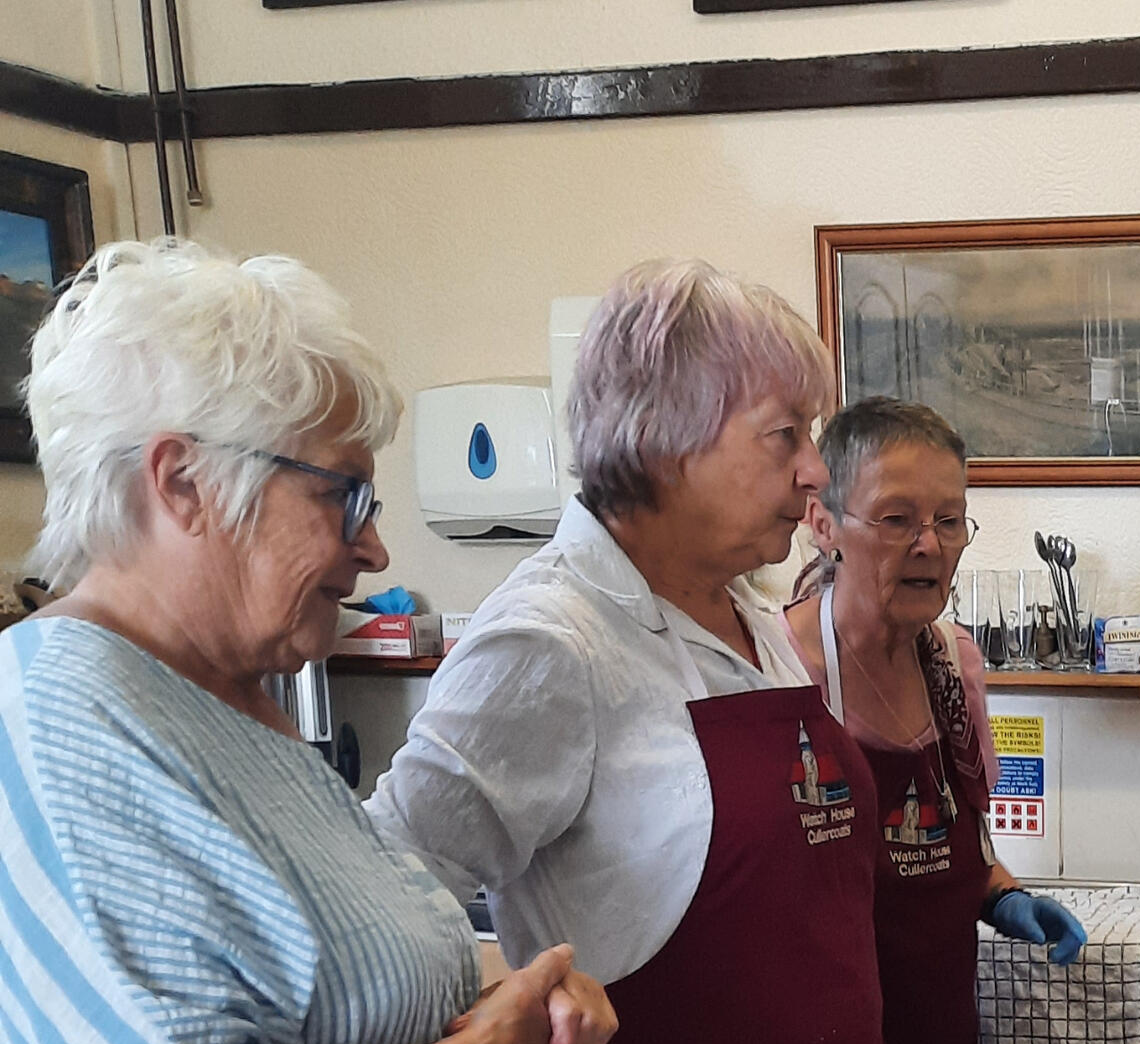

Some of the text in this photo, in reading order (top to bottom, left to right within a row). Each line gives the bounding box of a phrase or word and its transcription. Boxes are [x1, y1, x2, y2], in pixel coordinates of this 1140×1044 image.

[800, 806, 856, 829] Watch House
[889, 844, 951, 864] Watch House
[899, 859, 951, 877] Cullercoats
